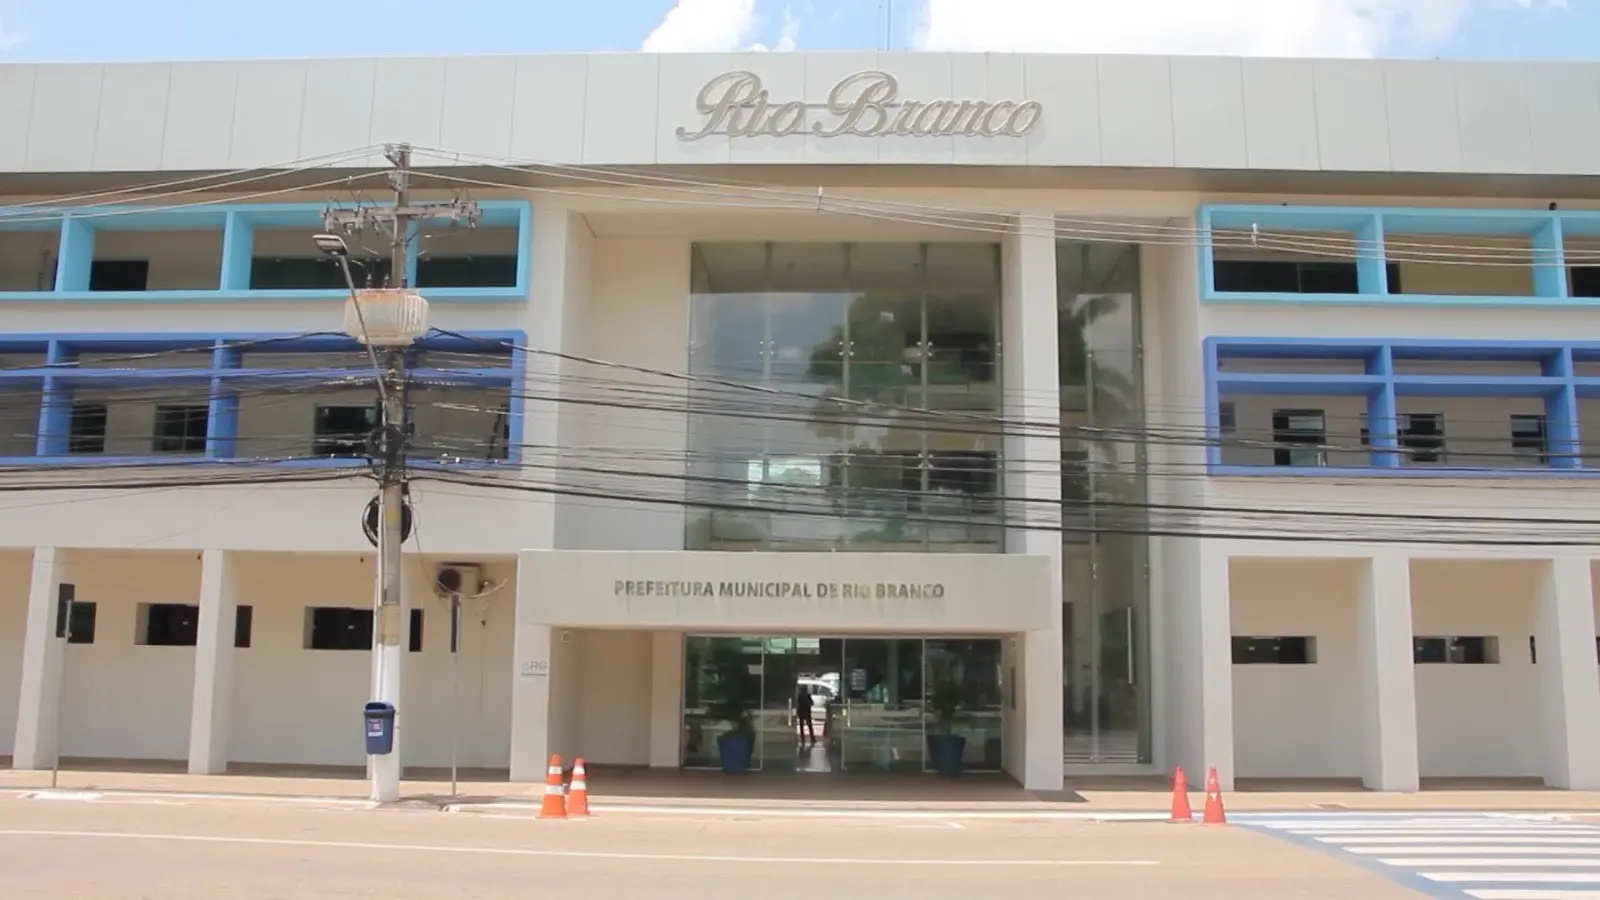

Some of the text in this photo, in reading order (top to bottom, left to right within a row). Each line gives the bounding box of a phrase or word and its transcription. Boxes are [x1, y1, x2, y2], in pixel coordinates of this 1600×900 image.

[675, 70, 1042, 141] Rio Branco
[614, 580, 945, 599] PREFEITURA MUNICIPAL DE RIO BRANCO
